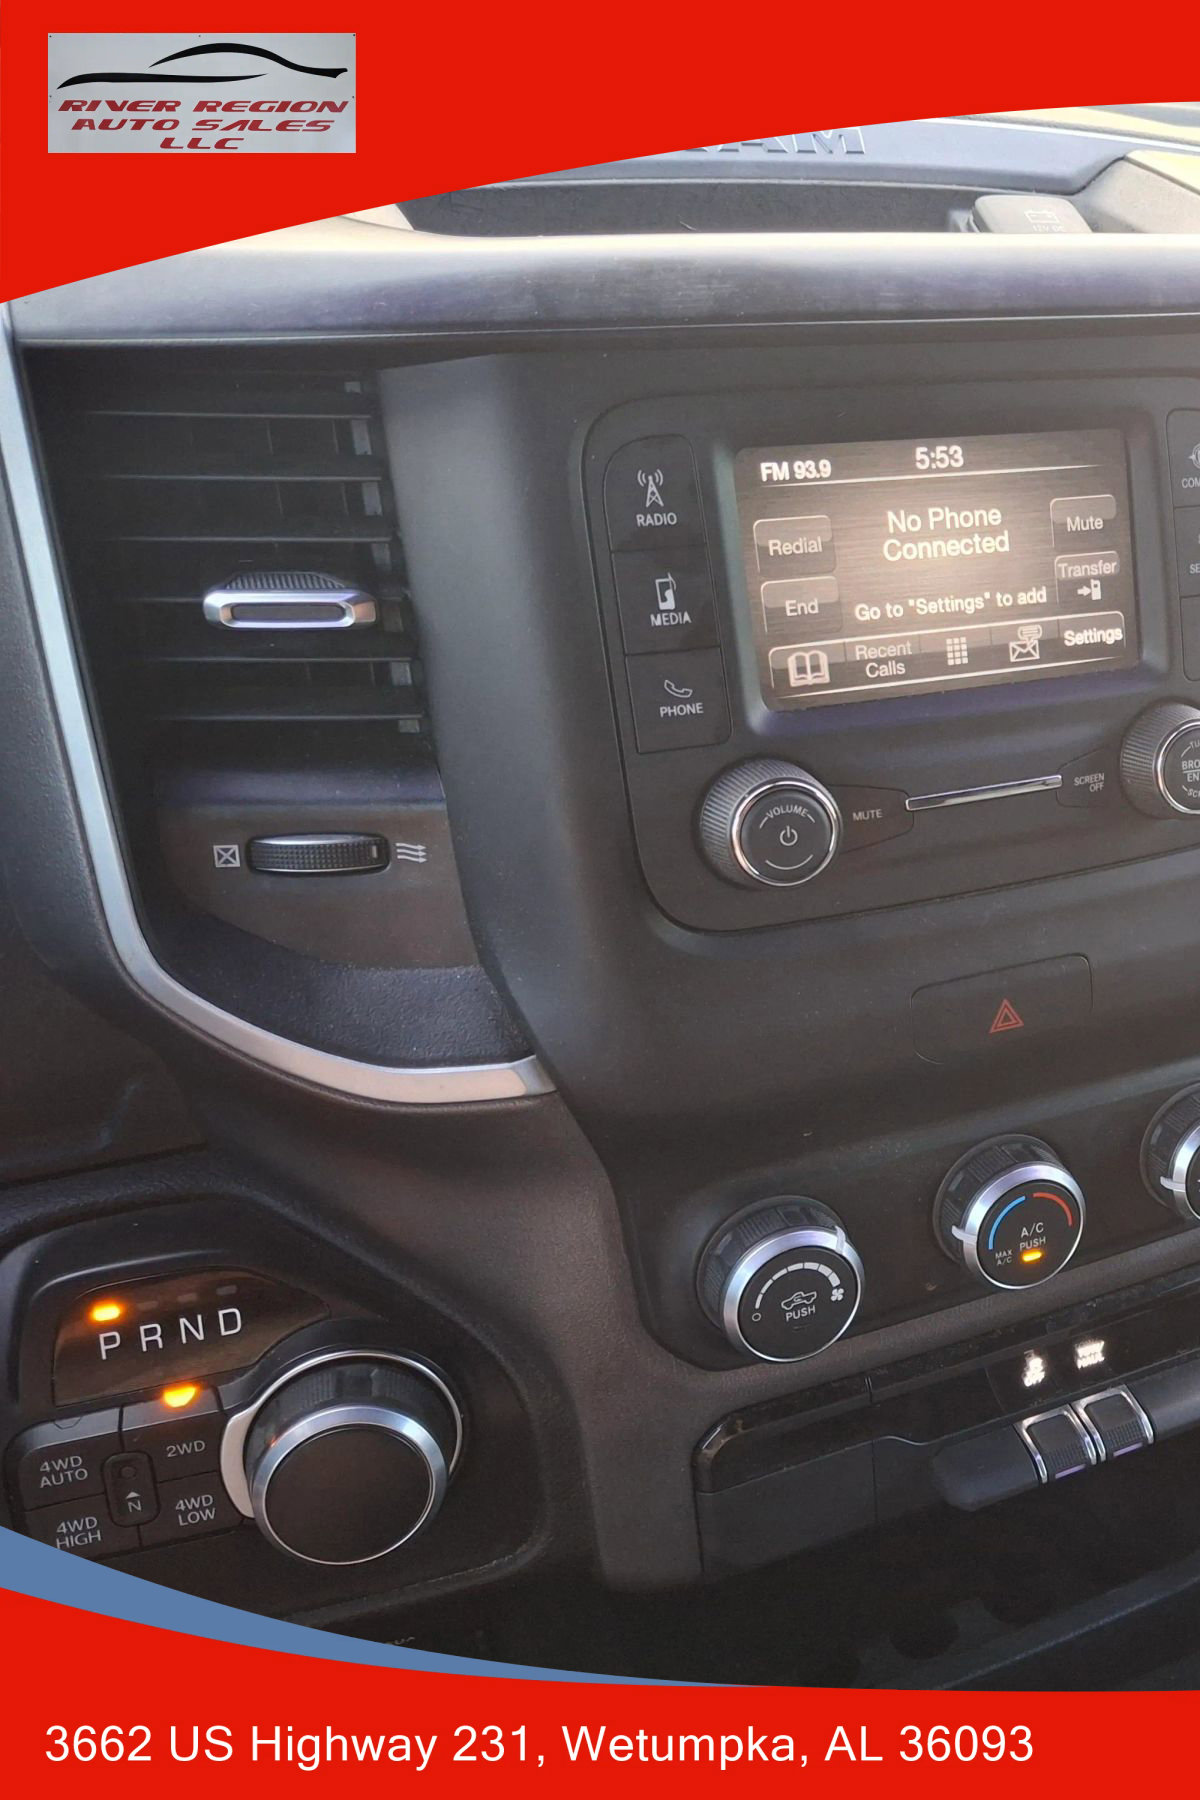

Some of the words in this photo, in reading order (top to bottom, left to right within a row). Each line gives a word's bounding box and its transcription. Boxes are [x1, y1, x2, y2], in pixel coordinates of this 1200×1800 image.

[915, 445, 964, 470] 5:53
[760, 461, 791, 482] FM
[794, 459, 832, 481] 93.9
[636, 513, 678, 527] RADIO
[887, 509, 922, 534] No
[928, 506, 1002, 530] Phone
[1066, 513, 1104, 532] Mute
[768, 536, 823, 557] Redial
[883, 530, 1011, 562] Connected
[1058, 557, 1117, 579] Transfer
[785, 598, 819, 617] End
[855, 603, 881, 622] Go
[885, 601, 904, 619] to
[908, 591, 992, 619] "Settings"
[996, 588, 1014, 607] to
[1017, 586, 1047, 606] add
[651, 611, 692, 627] MEDIA
[1064, 623, 1124, 650] Settings
[855, 640, 912, 661] Recent
[865, 660, 906, 680] Calls
[660, 703, 704, 718] PHONE
[1074, 772, 1105, 786] SCREEN
[1089, 782, 1105, 792] OFF
[766, 804, 808, 820] VOLUME
[852, 809, 883, 822] MUTE
[1021, 1222, 1044, 1238] A/C
[1020, 1236, 1046, 1251] PUSH
[995, 1249, 1013, 1259] MAX
[785, 1305, 816, 1322] PUSH
[99, 1331, 122, 1360] P
[140, 1323, 164, 1352] R
[179, 1314, 205, 1344] N
[218, 1307, 243, 1336] D
[166, 1440, 206, 1458] 2WD
[40, 1455, 83, 1473] 4WD
[40, 1468, 88, 1489] AUTO
[128, 1500, 142, 1513] N
[175, 1494, 214, 1512] 4WD
[56, 1516, 98, 1535] 4WD
[178, 1508, 216, 1527] LOW
[56, 1529, 102, 1549] HIGH
